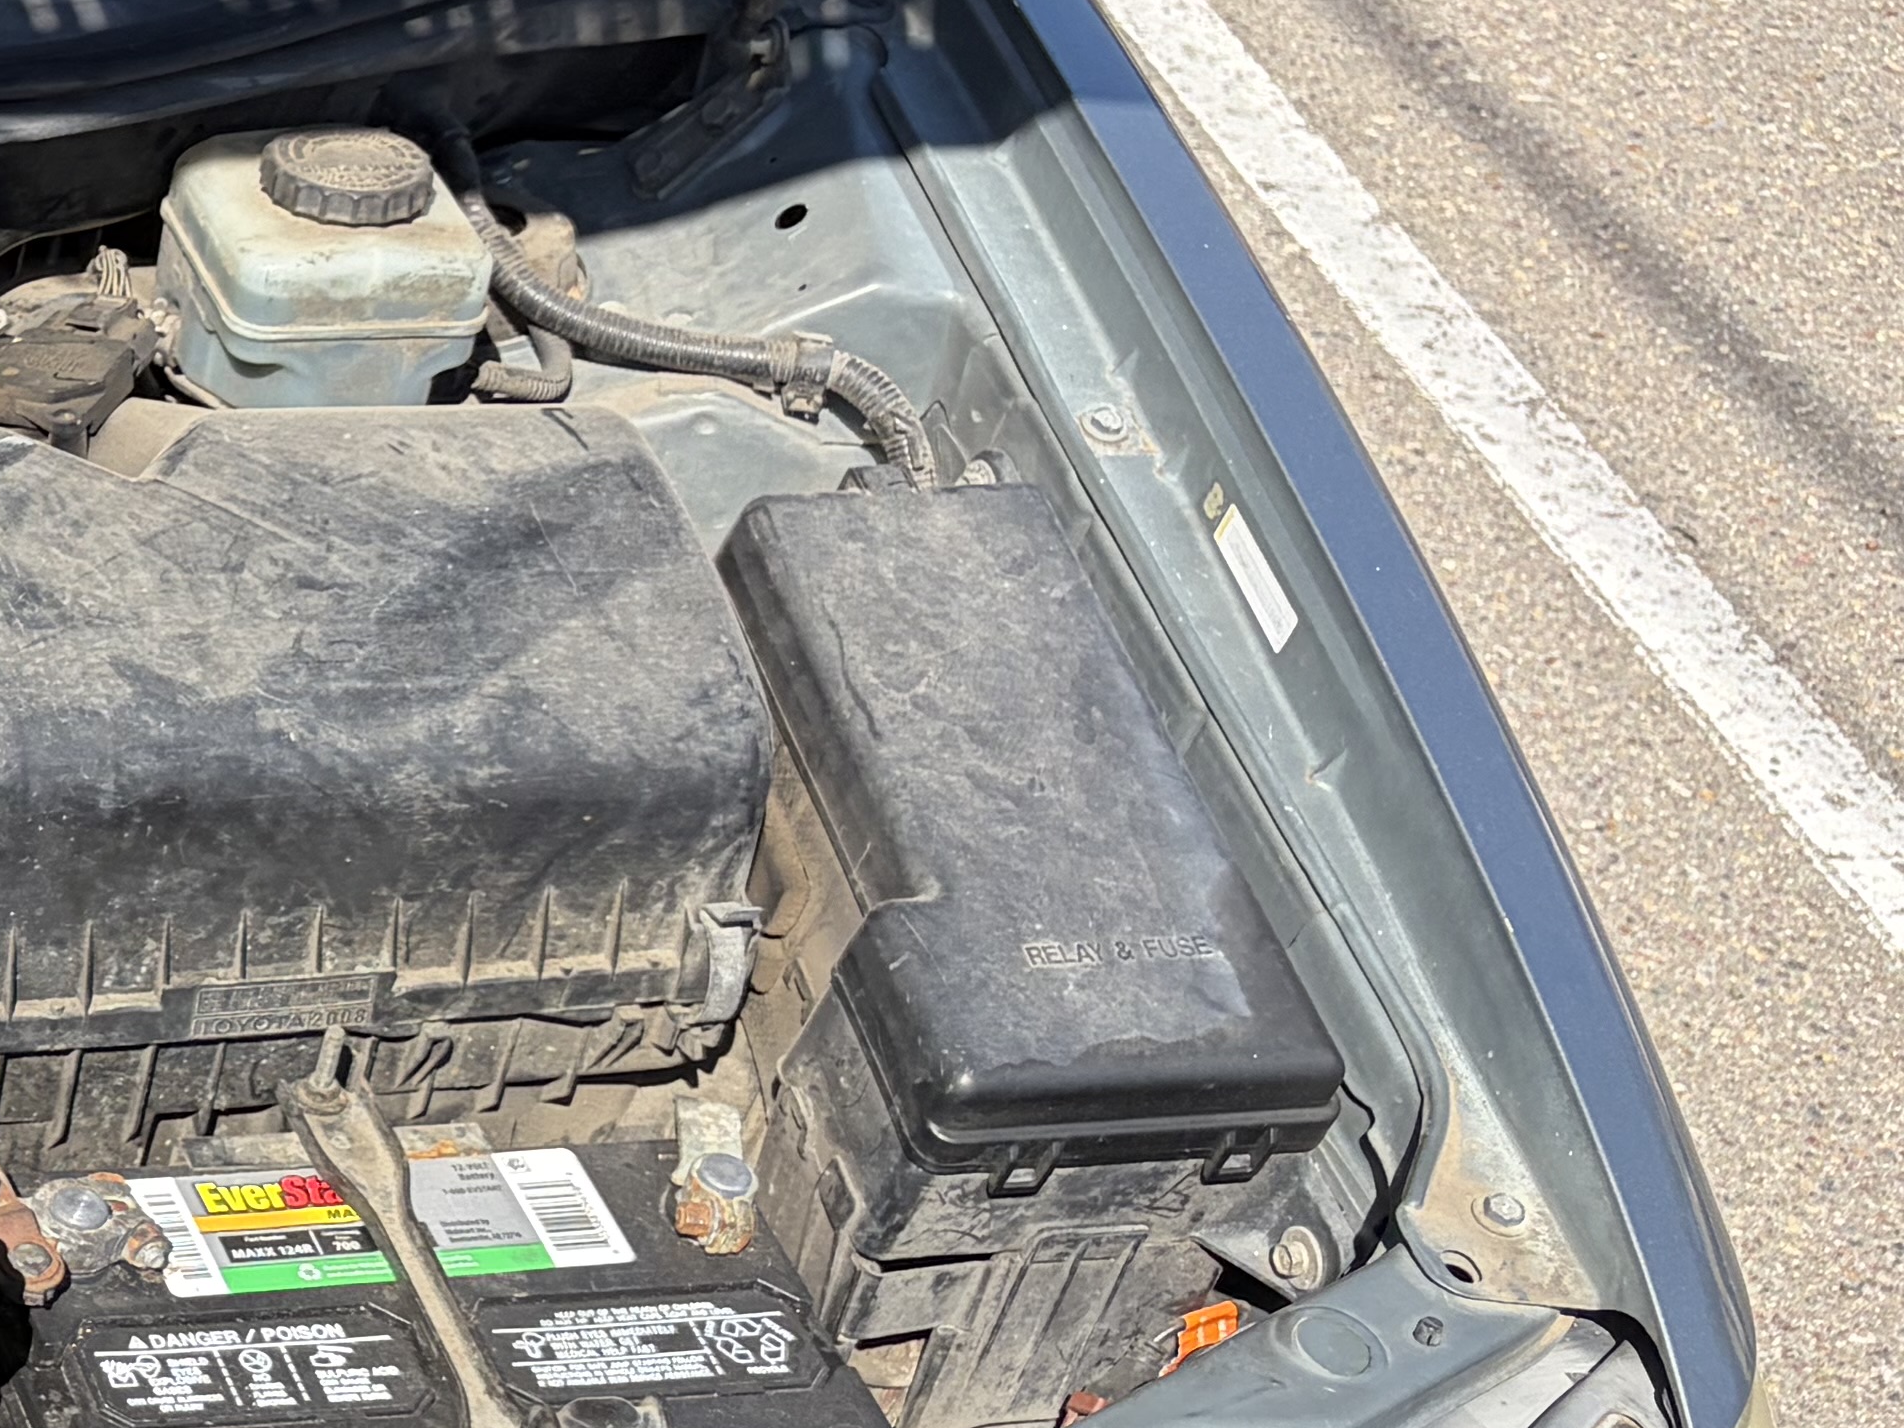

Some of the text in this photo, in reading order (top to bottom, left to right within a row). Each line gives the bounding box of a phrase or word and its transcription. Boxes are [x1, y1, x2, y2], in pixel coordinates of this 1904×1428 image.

[1025, 935, 1215, 968] RELAY & FUSE
[195, 1174, 344, 1213] EverSta
[326, 1209, 358, 1221] MA
[231, 1245, 276, 1260] MAXX
[332, 1240, 362, 1251] 700
[148, 1324, 346, 1349] DANGER / POISON
